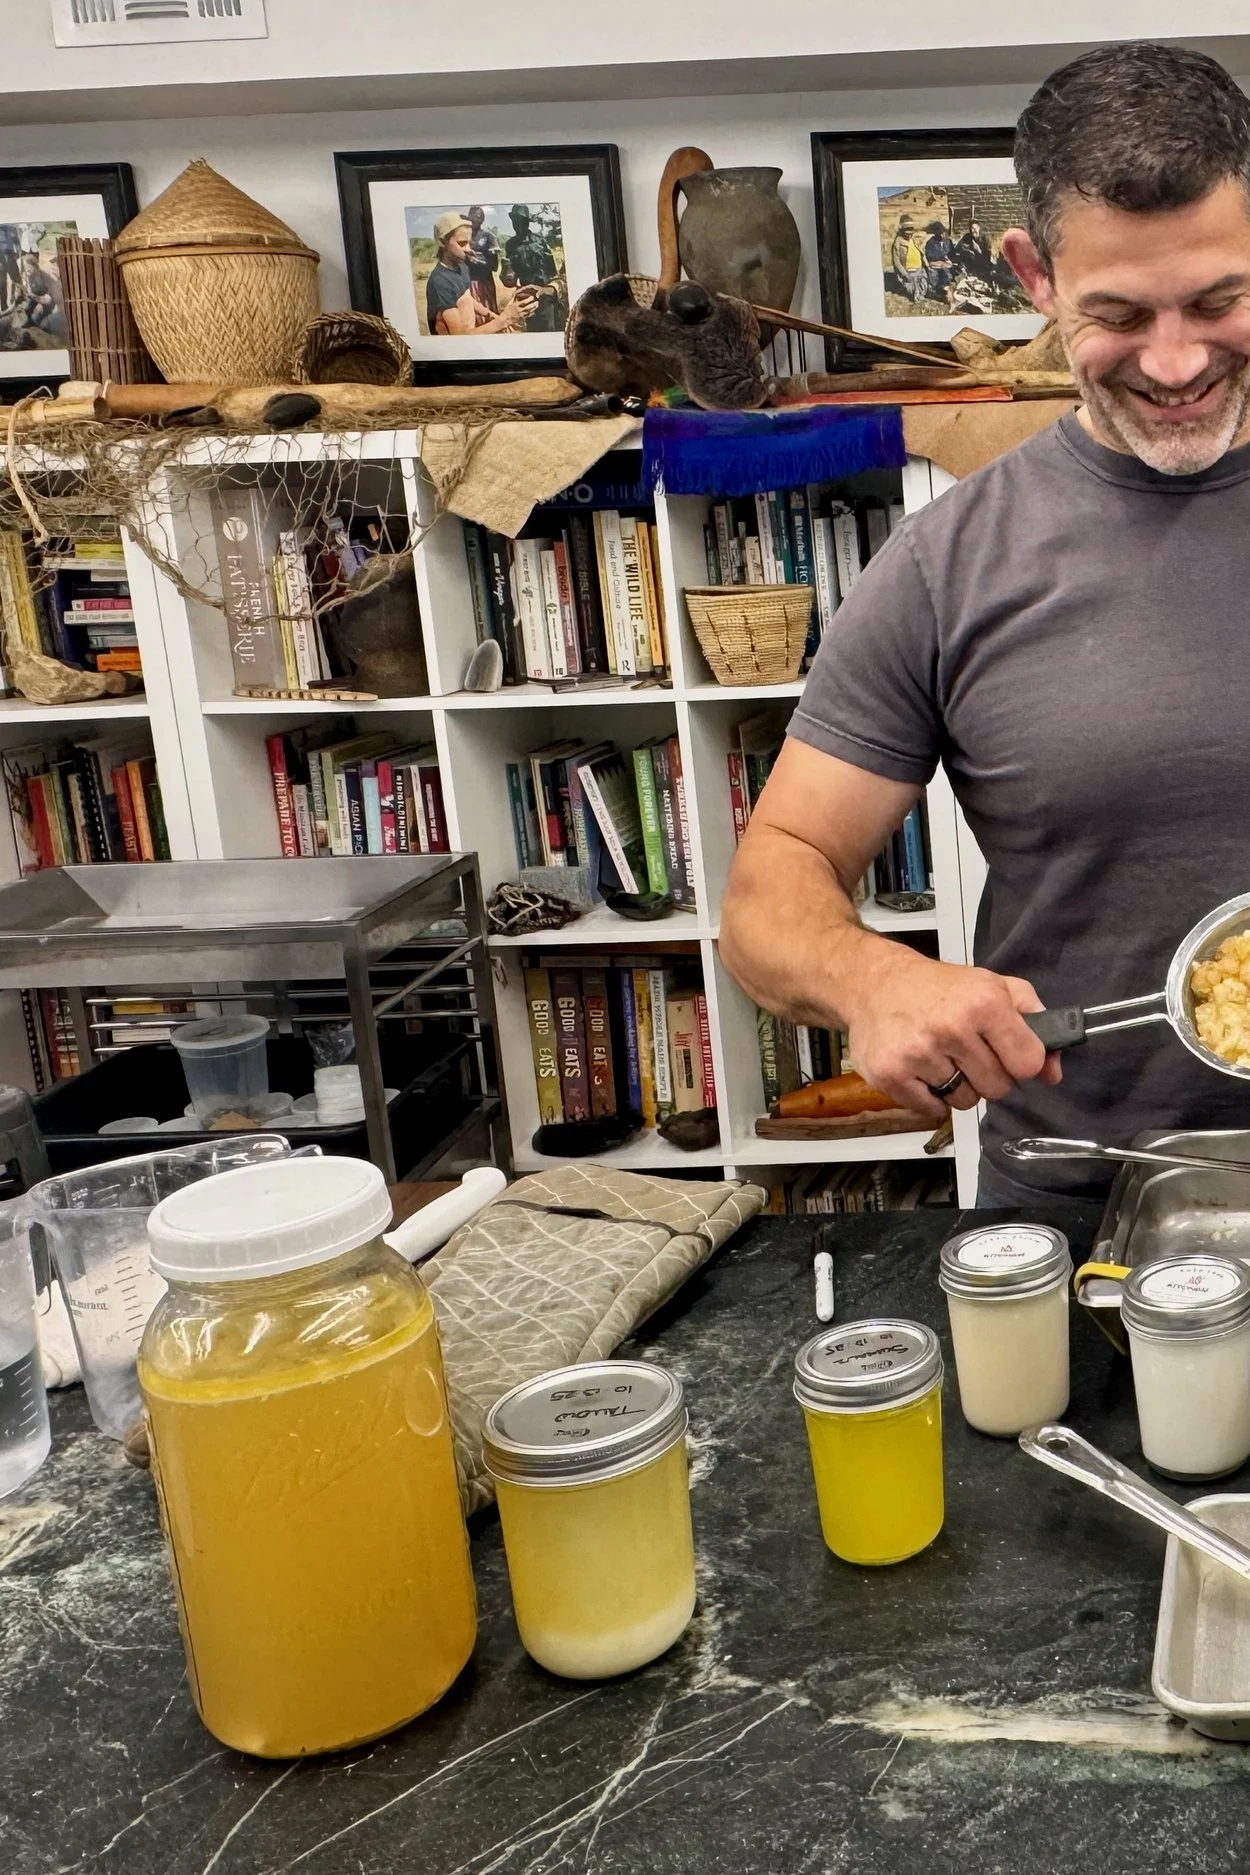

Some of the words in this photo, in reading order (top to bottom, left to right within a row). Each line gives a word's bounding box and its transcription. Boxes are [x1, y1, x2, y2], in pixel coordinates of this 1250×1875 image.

[627, 594, 643, 621] LIFE
[350, 799, 363, 832] ASIAN
[282, 827, 294, 846] TO
[531, 1000, 549, 1035] GOOD
[558, 997, 576, 1032] GOOD
[589, 999, 605, 1032] GOOD
[539, 1047, 557, 1078] EATS
[564, 1048, 581, 1078] EATS
[593, 1047, 606, 1073] EATS
[614, 1385, 633, 1394] 10
